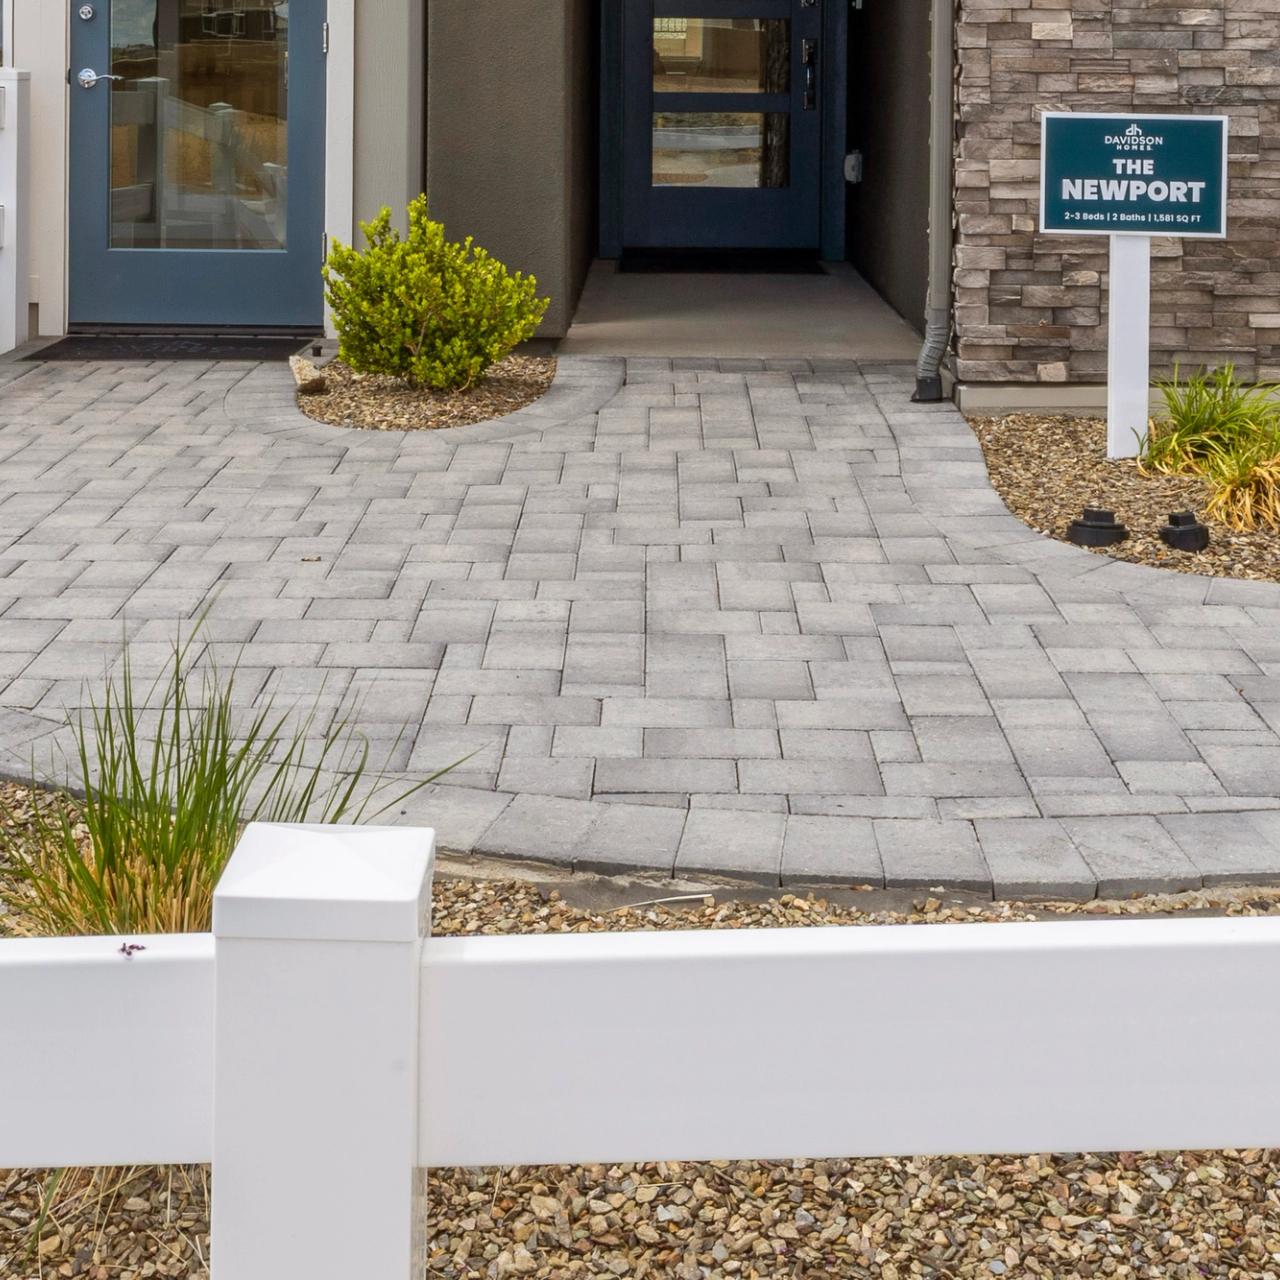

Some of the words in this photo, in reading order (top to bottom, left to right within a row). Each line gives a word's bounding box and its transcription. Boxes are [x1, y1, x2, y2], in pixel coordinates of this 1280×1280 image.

[1104, 135, 1163, 145] DAVIDSON
[1112, 158, 1155, 175] THE
[1061, 178, 1206, 203] NEWPORT
[1064, 211, 1081, 221] 2-3
[1082, 211, 1105, 221] Beds
[1112, 213, 1118, 221] 2
[1120, 212, 1146, 222] Baths
[1153, 213, 1174, 223] 1,581
[1176, 214, 1189, 223] SQ
[1191, 215, 1201, 223] FT
